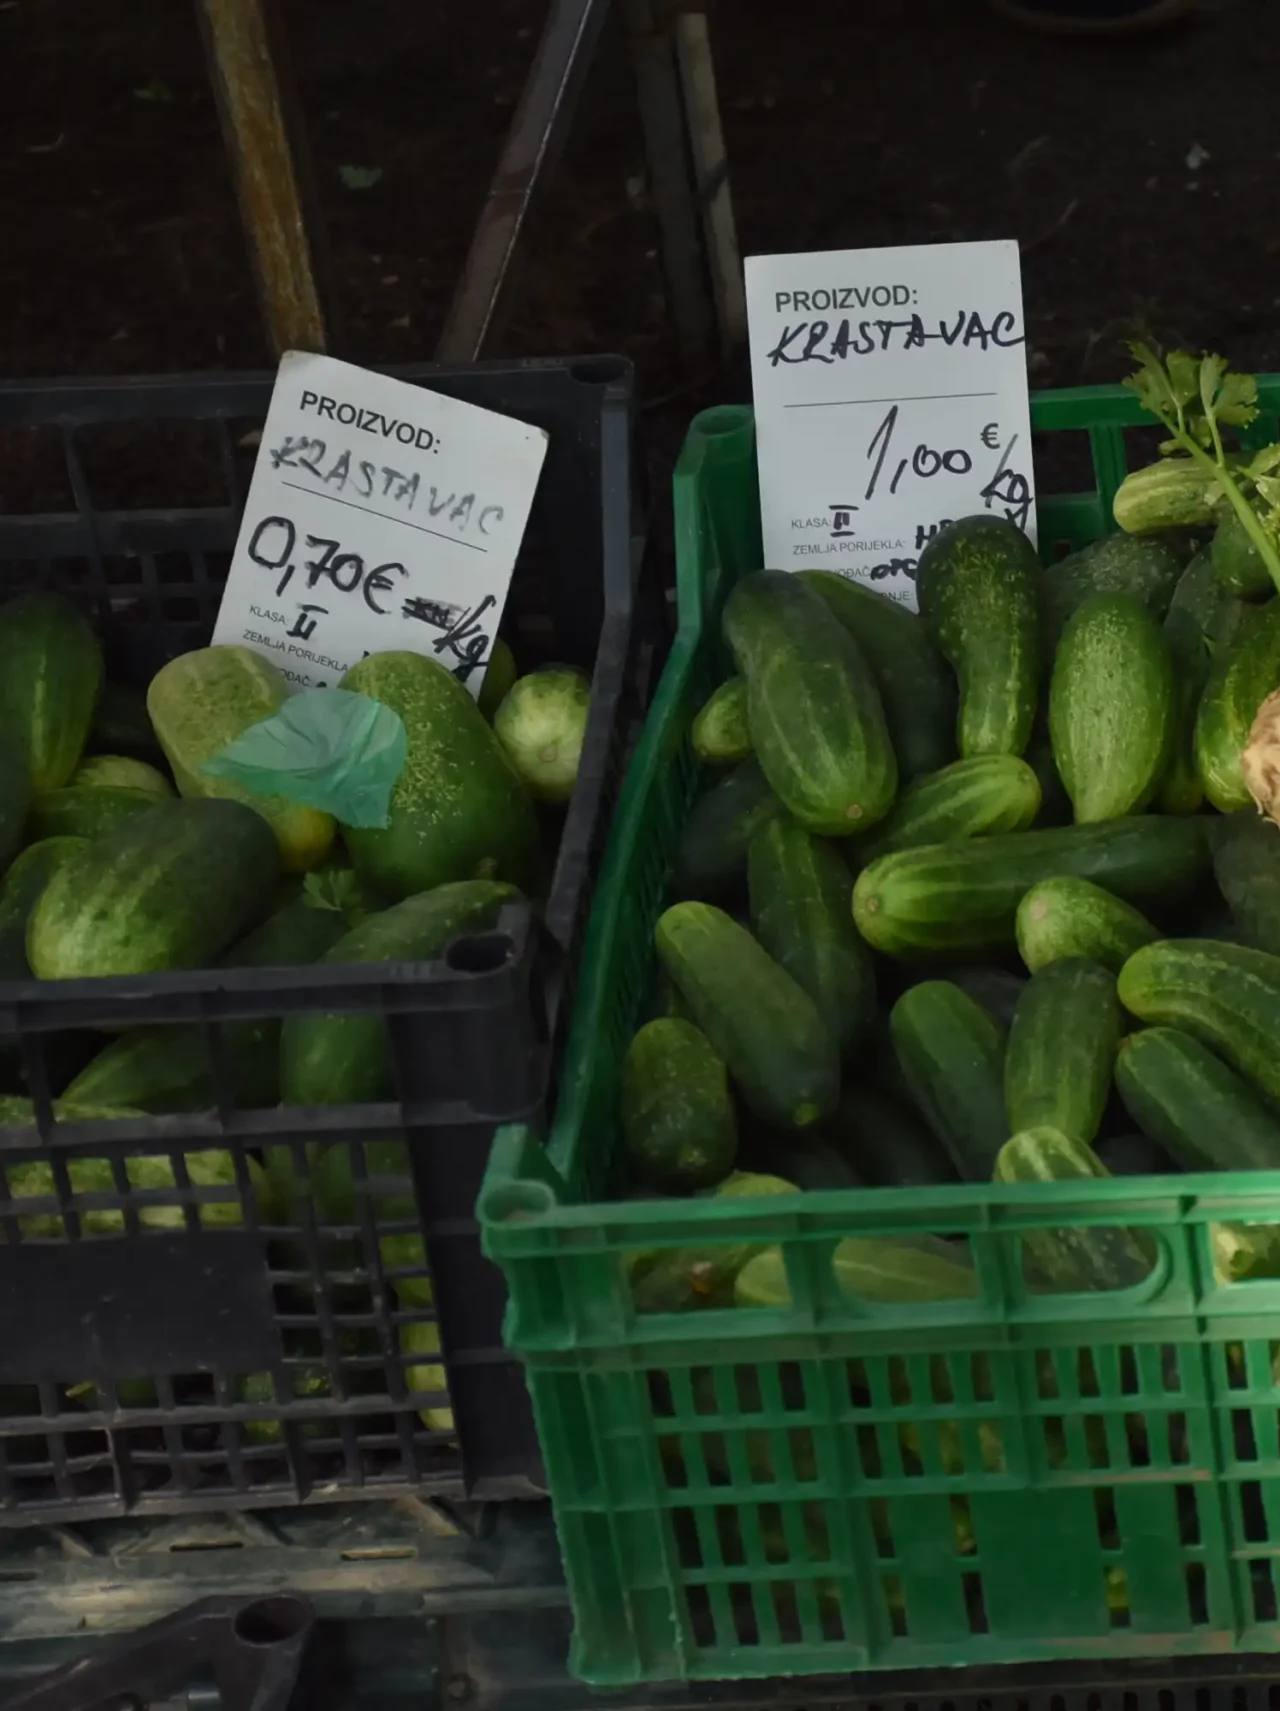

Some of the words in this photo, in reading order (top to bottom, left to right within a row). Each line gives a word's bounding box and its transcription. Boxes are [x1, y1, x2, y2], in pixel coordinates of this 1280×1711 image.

[775, 285, 919, 313] PROIZVOD:
[767, 310, 1026, 367] KRASTAVAC
[299, 389, 442, 455] PROIZVOD:
[791, 517, 832, 530] KLASA:
[793, 544, 838, 556] ZEMLJA
[840, 539, 906, 553] PORIJEKLA:
[249, 604, 289, 627] KLASA:
[242, 628, 286, 653] ZEMLJA
